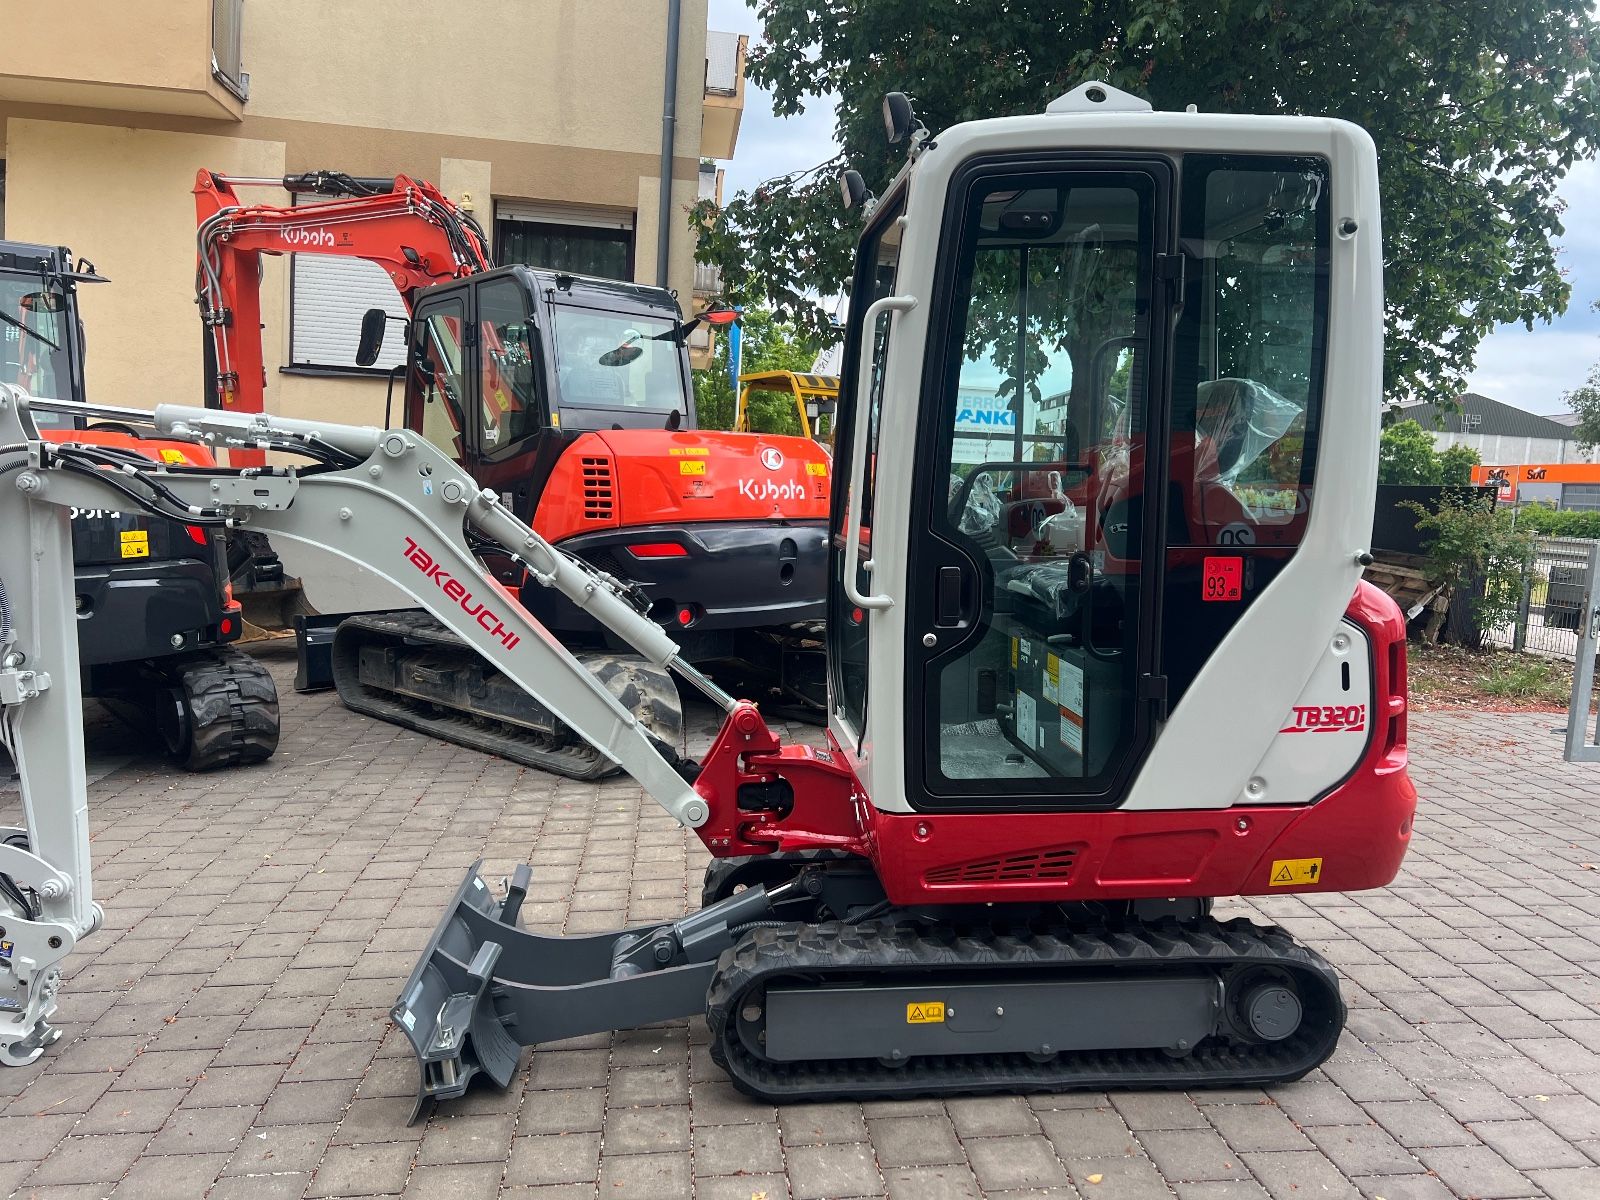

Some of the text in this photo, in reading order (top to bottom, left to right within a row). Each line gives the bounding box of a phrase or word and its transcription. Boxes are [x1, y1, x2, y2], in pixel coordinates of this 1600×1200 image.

[280, 227, 335, 247] Kubota
[738, 479, 805, 500] Kubota
[403, 536, 521, 651] TAKEUCHI
[1207, 576, 1238, 597] 93 dB
